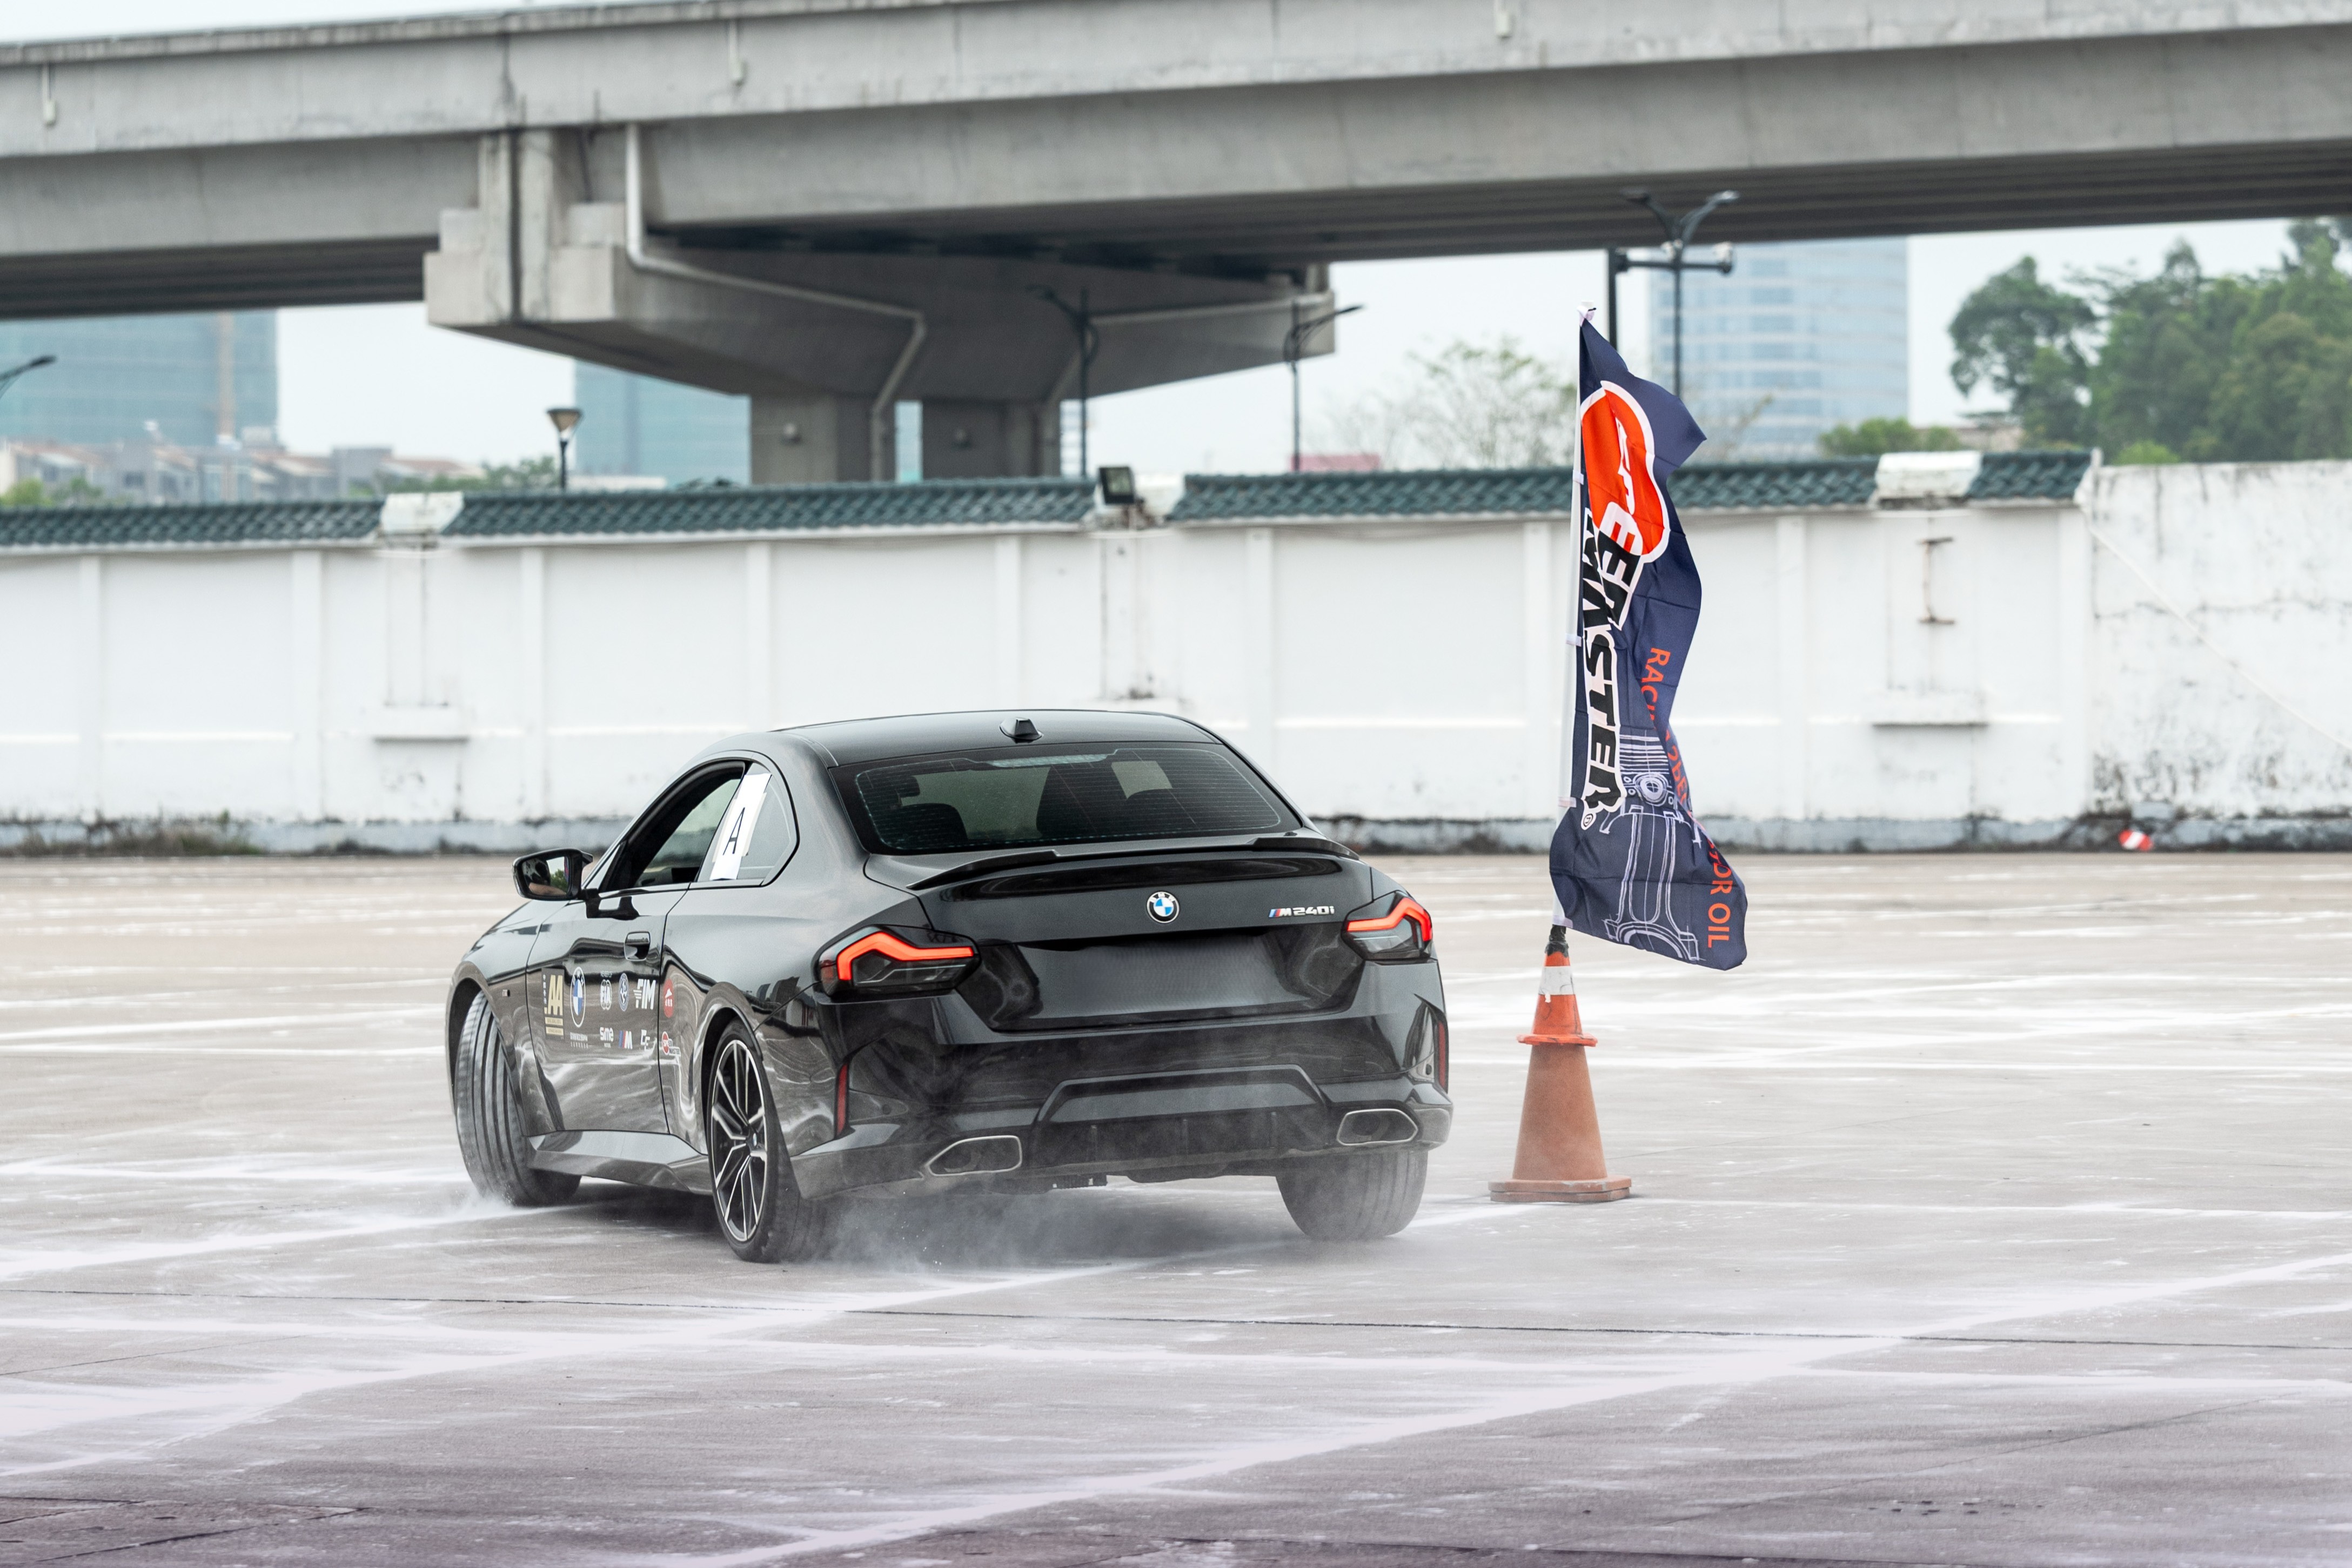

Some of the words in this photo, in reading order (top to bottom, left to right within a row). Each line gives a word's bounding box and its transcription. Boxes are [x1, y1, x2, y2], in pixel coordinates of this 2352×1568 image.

[722, 807, 745, 856] A
[1275, 906, 1335, 917] M240i
[1708, 903, 1731, 948] OIL
[633, 979, 656, 1010] FIM
